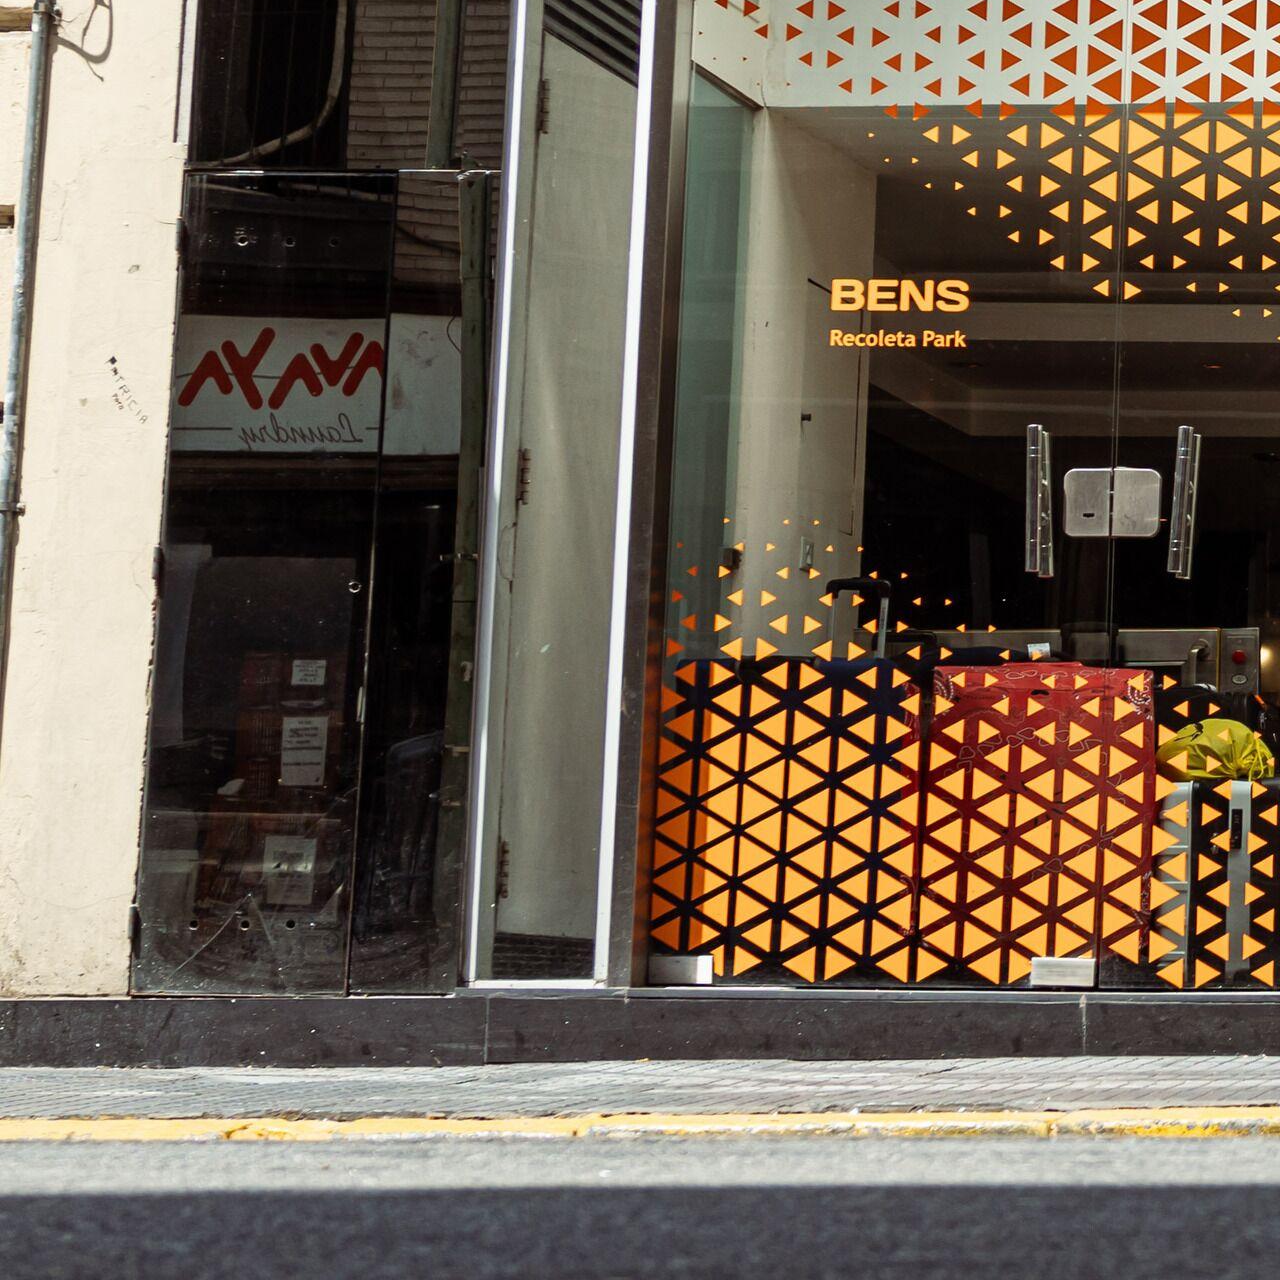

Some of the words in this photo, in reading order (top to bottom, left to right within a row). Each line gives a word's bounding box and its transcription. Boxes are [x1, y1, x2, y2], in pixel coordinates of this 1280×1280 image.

[830, 278, 970, 313] BENS
[829, 329, 916, 347] Recoleta
[922, 330, 967, 348] Park
